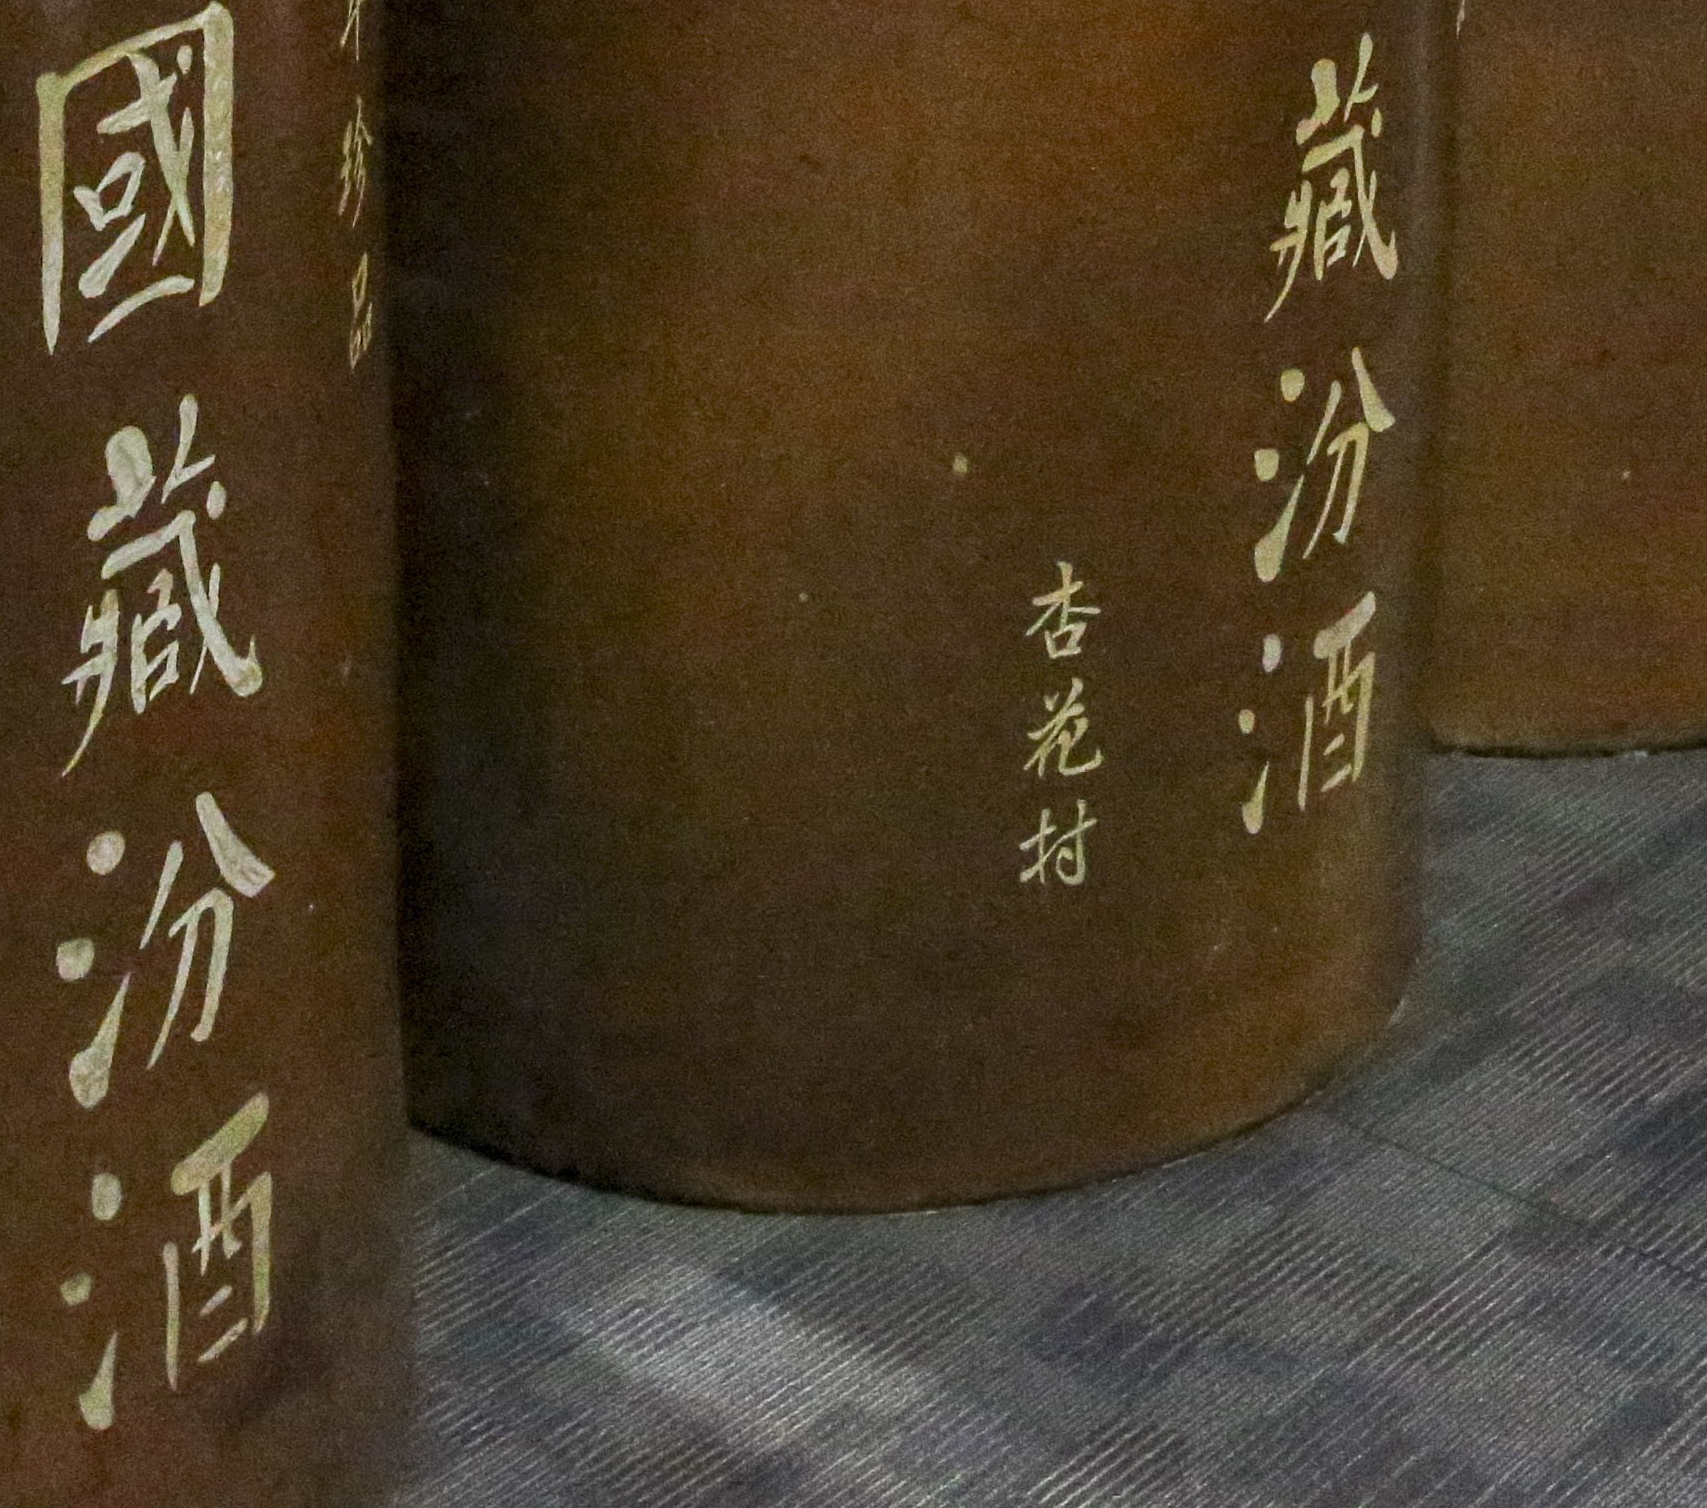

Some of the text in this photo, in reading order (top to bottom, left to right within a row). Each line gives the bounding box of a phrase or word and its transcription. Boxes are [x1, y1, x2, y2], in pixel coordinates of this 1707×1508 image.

[36, 1, 275, 1431] 國藏汾酒
[1018, 561, 1104, 886] 杏花村
